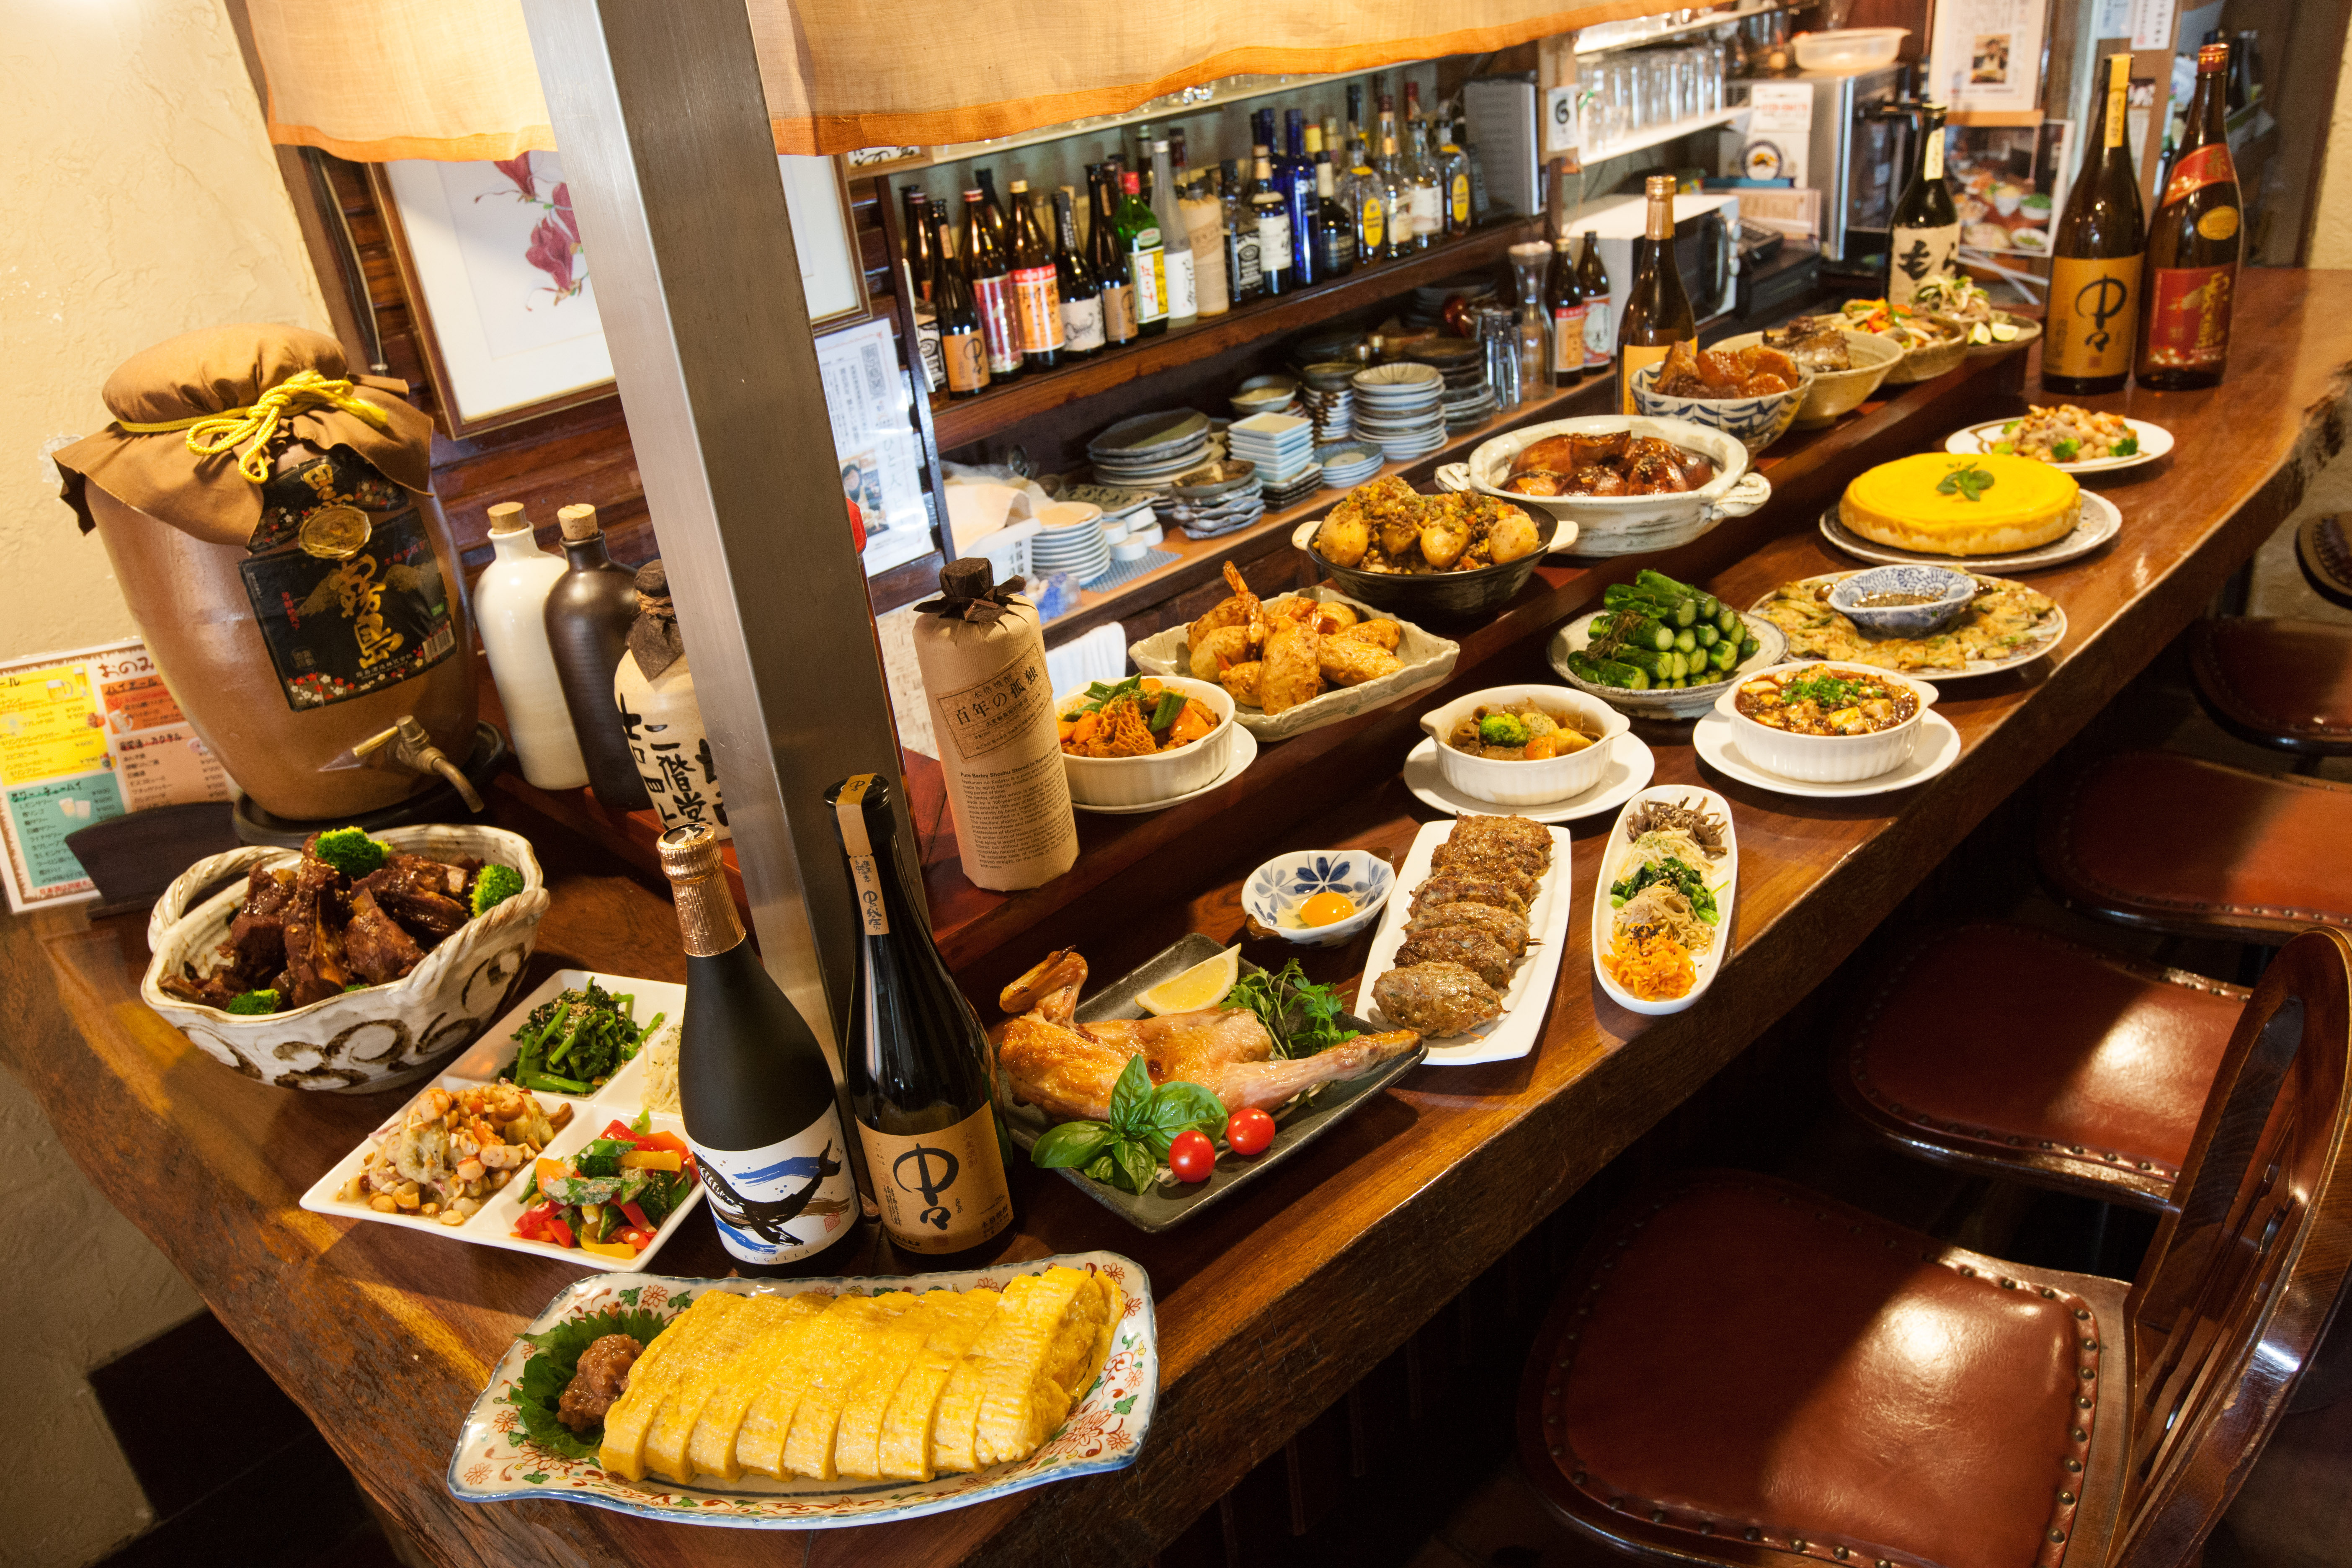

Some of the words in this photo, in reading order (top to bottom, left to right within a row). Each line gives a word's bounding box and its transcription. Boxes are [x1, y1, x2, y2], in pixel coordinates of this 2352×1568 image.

[956, 666, 1038, 725] 百年の孤独
[974, 673, 1013, 699] 本格焼酎
[1012, 764, 1029, 773] Stored
[1035, 754, 1048, 764] Barrels
[744, 1249, 810, 1262] KUGILLA
